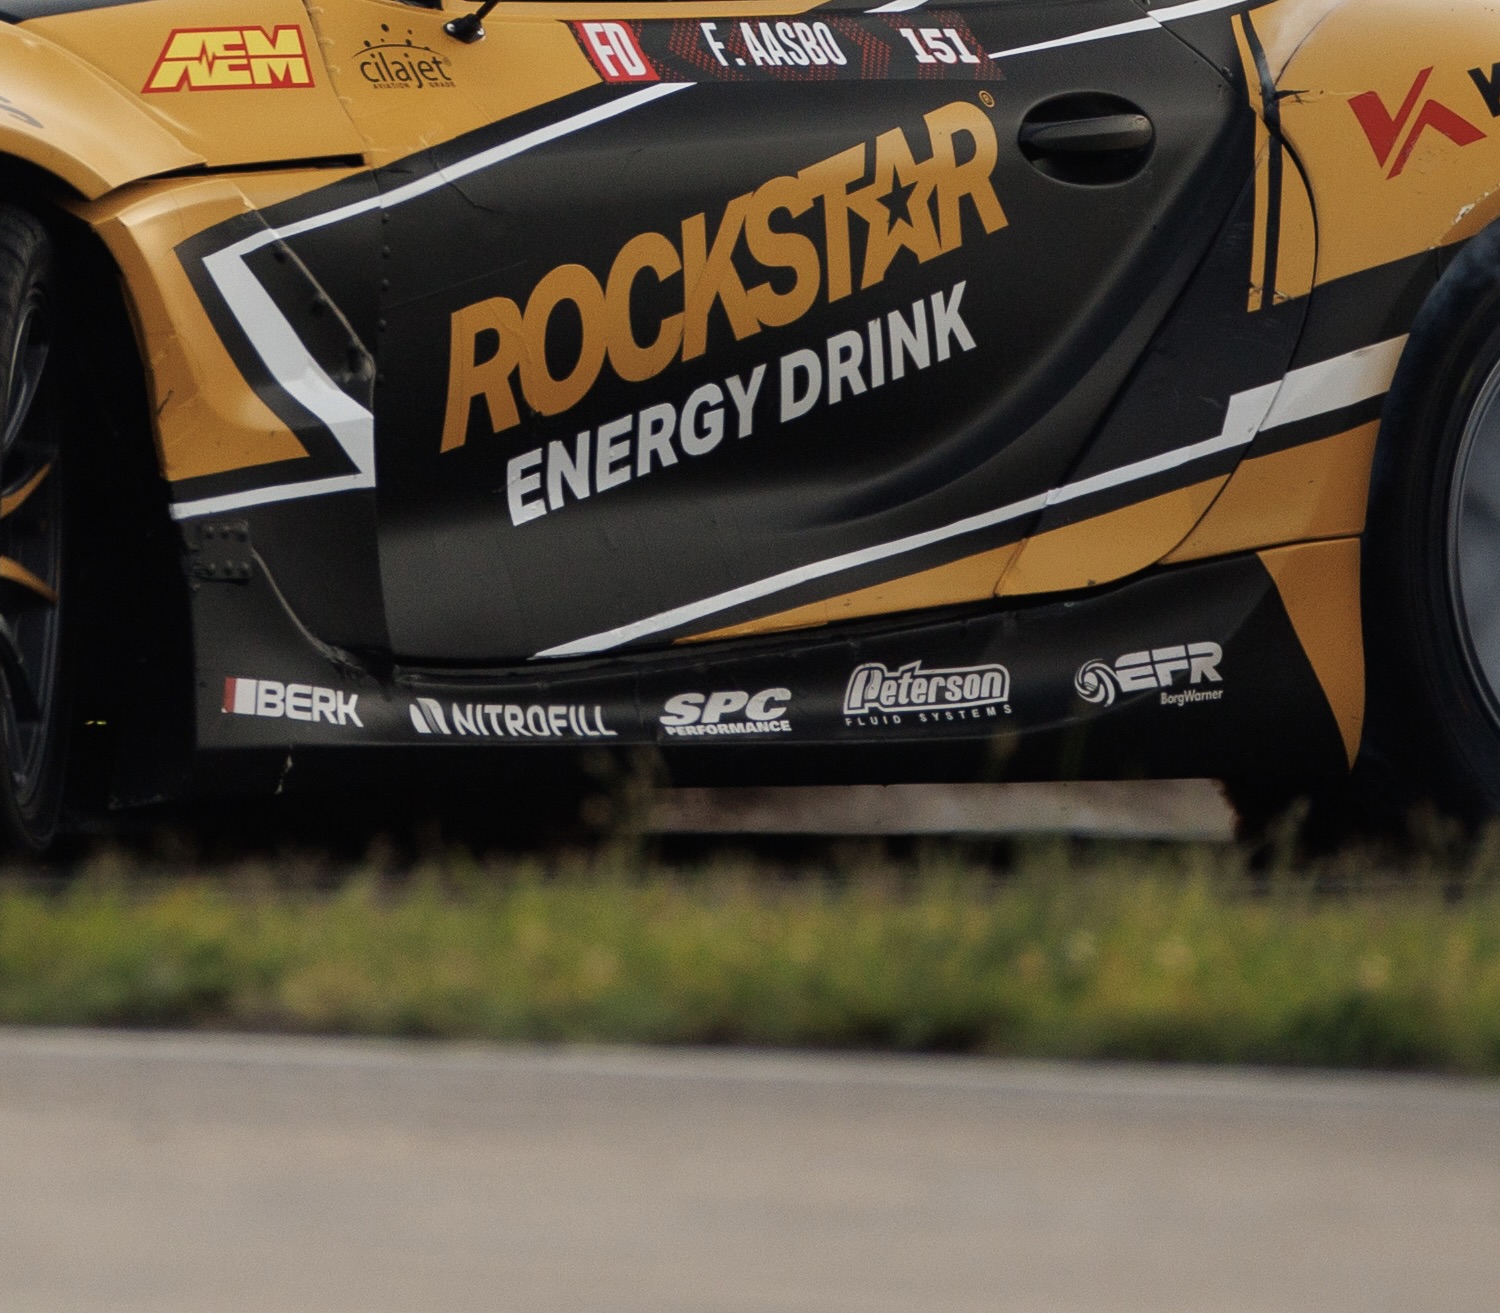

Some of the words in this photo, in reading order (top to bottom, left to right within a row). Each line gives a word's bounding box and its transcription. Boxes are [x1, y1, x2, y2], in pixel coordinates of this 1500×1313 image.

[582, 21, 648, 76] FD
[740, 21, 847, 66] AASBO
[900, 27, 980, 65] 151
[359, 51, 452, 88] cilajet
[440, 101, 1009, 453] ROCKSTAR
[507, 364, 767, 526] ENERGY
[780, 280, 976, 423] DRINK
[1114, 641, 1223, 693] EFR
[256, 680, 364, 728] BERK
[659, 688, 792, 726] SPC
[849, 667, 1001, 708] Peterson
[1160, 689, 1224, 707] BorgWarner
[452, 703, 618, 737] NITROFILL
[664, 720, 793, 736] PERFORMANCE
[844, 715, 902, 727] FLUID
[919, 704, 1013, 723] SYSTEMS
